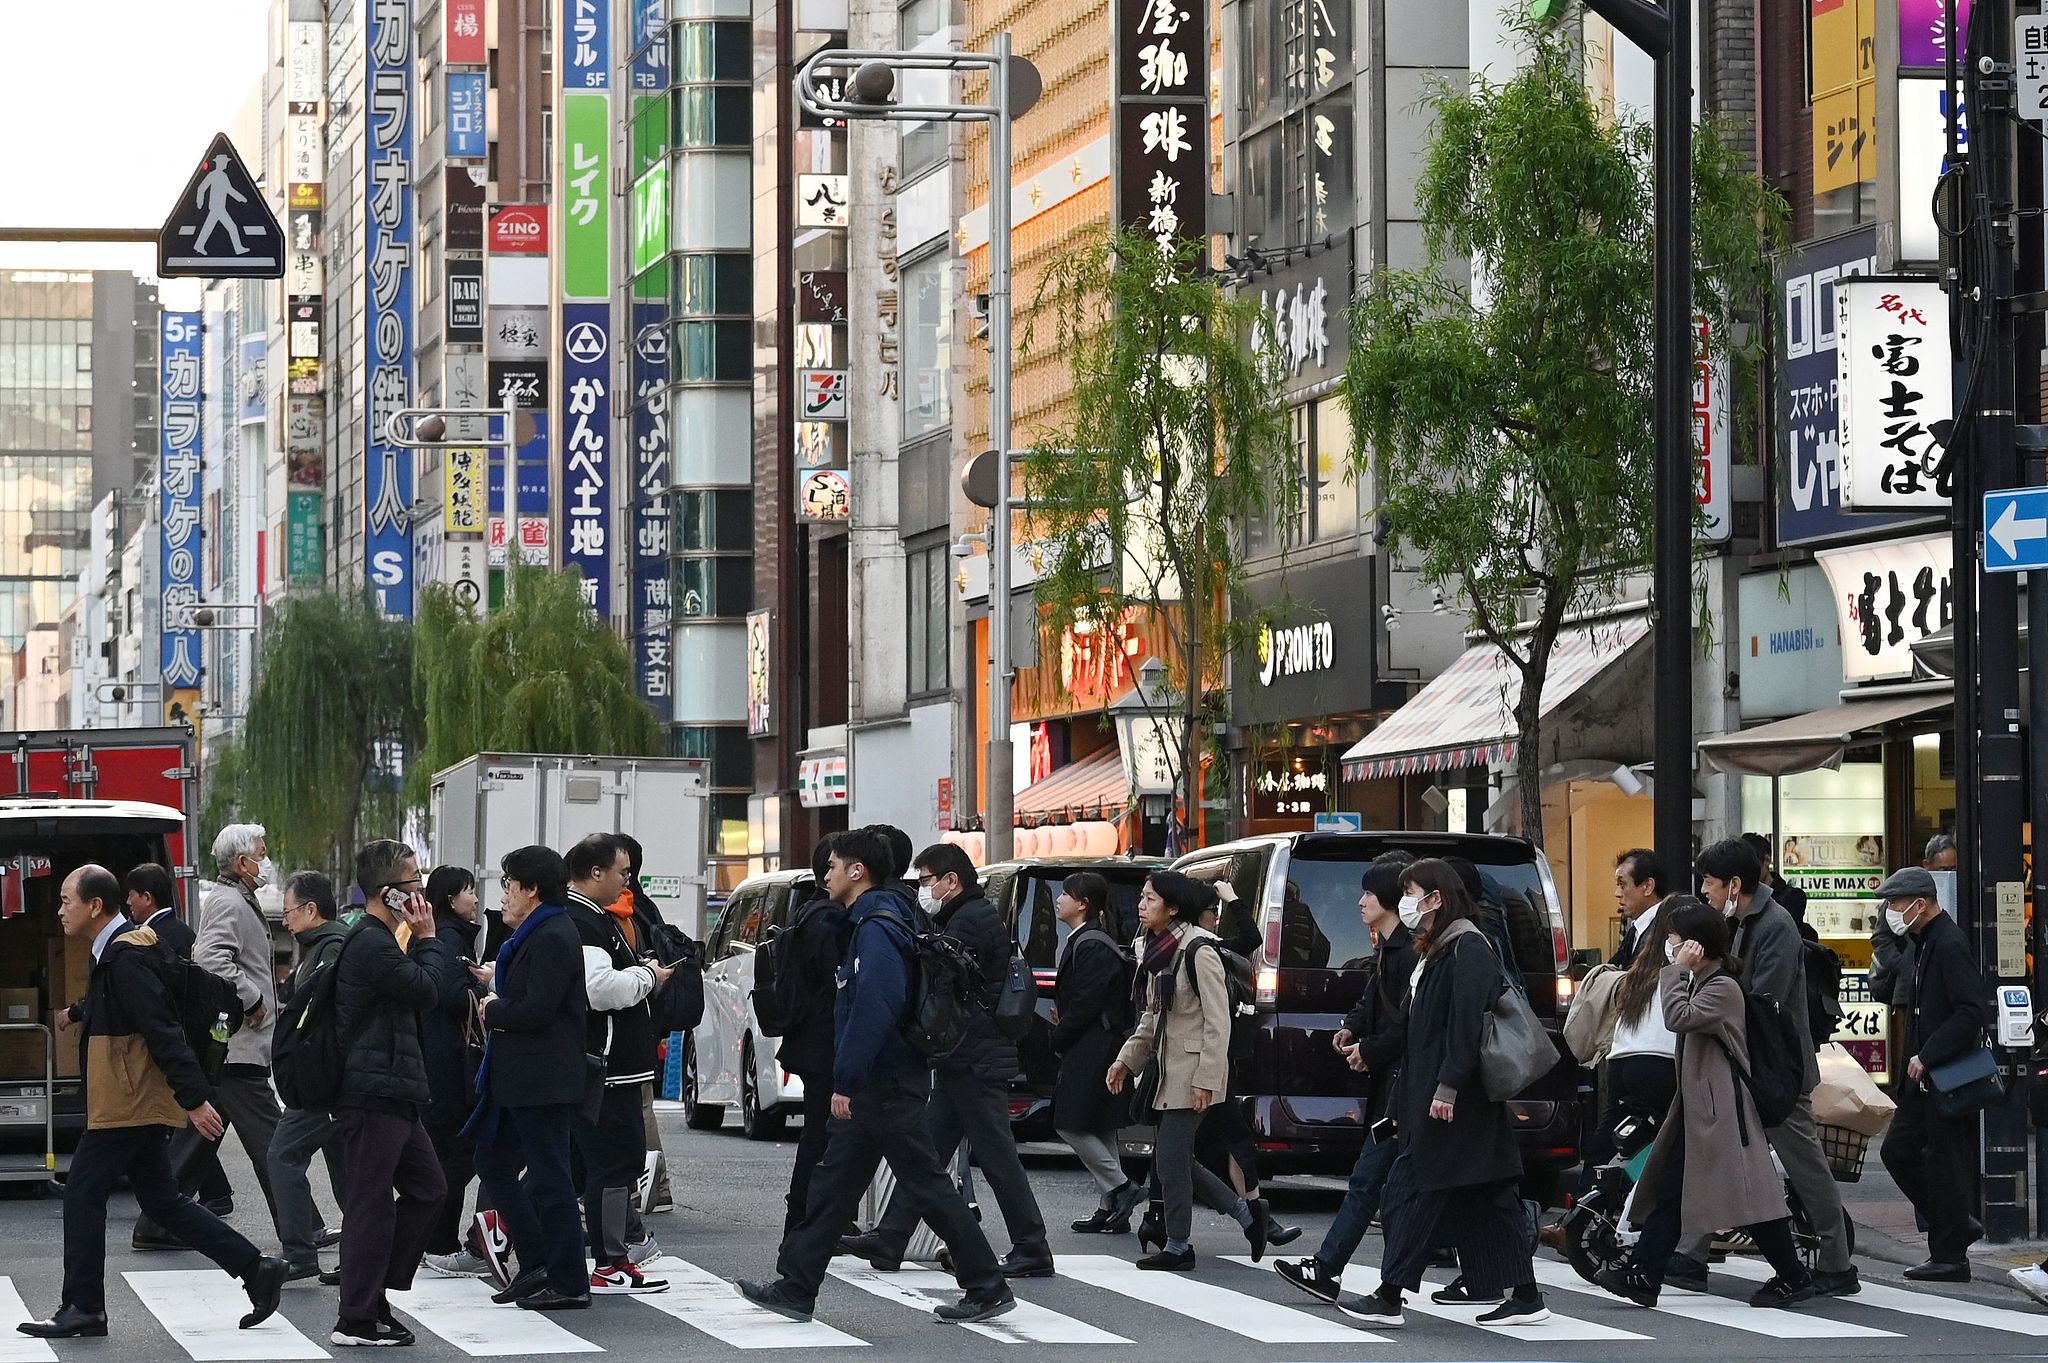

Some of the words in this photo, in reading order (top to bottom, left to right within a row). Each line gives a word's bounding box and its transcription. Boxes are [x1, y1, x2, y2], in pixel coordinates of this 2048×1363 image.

[574, 0, 598, 67] トラル
[2025, 25, 2048, 49] 自
[1860, 36, 1875, 70] T
[586, 73, 605, 87] 5F
[298, 103, 313, 113] 7F
[452, 90, 472, 150] ジロー
[297, 119, 309, 179] とり酒場
[1827, 116, 1875, 171] ジン
[297, 184, 313, 196] 6F
[571, 143, 599, 225] レイク
[497, 222, 540, 234] ZINO
[1147, 170, 1180, 293] 新橋茶
[453, 282, 479, 300] BAR
[454, 314, 478, 323] LIGHT
[455, 304, 477, 313] MOON
[1875, 294, 1927, 325] 名代
[165, 316, 198, 342] 5F
[568, 377, 605, 556] かんべ土地
[164, 349, 200, 686] カラオケの鉄人
[1275, 621, 1333, 677] PRONTO
[1770, 627, 1813, 655] HANABISI
[1801, 877, 1830, 889] LiVE
[1834, 877, 1866, 889] MAX
[1301, 1266, 1316, 1281] N
